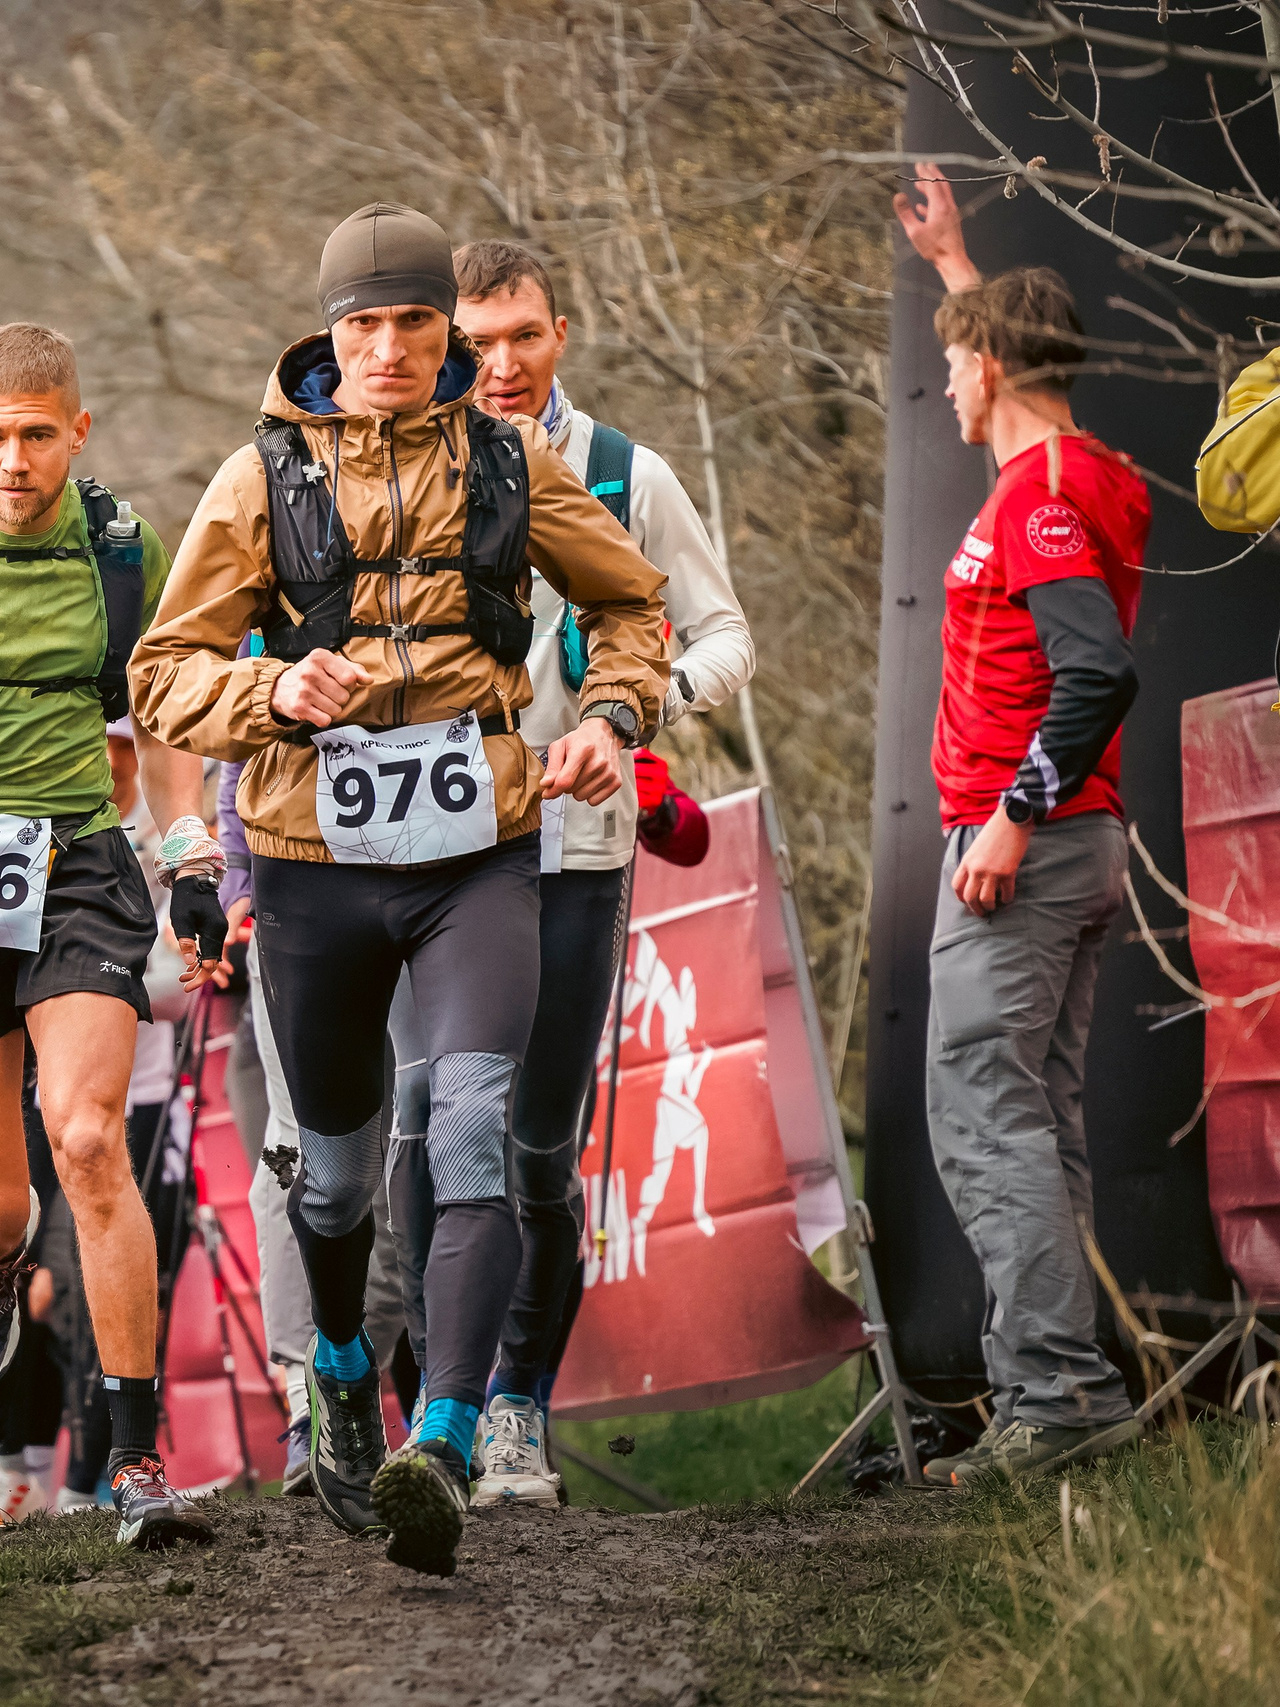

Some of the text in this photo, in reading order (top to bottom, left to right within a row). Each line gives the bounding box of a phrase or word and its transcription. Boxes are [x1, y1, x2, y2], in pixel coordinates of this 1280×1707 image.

[360, 739, 431, 750] КРЕСТ ПЛЮС
[332, 752, 478, 829] 976
